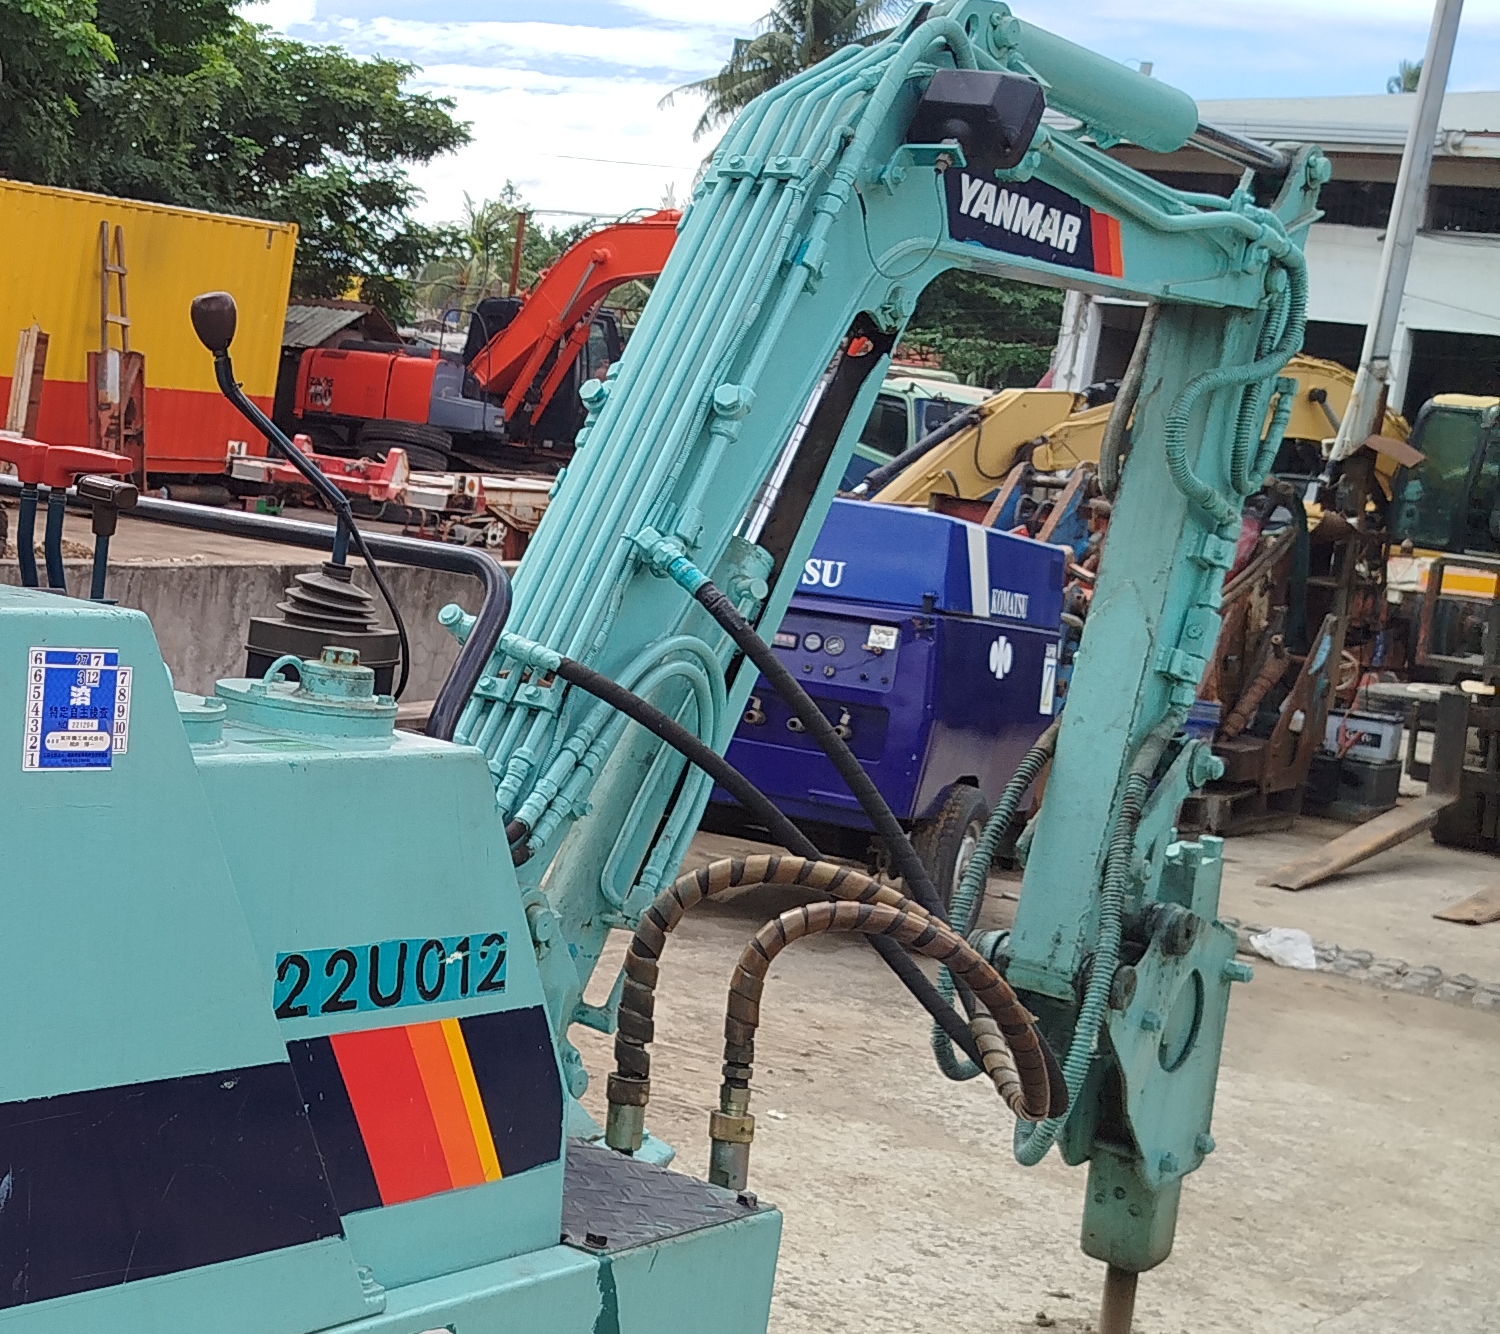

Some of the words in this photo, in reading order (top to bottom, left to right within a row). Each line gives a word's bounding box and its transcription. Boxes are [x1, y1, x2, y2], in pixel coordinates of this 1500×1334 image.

[959, 173, 1082, 254] YANMAR
[990, 589, 1028, 619] KOMATSU
[34, 669, 42, 682] 6
[87, 671, 99, 684] 12
[119, 671, 127, 684] 7
[32, 686, 41, 699] 5
[117, 688, 127, 702] 8
[31, 702, 40, 716] 4
[117, 705, 125, 717] 9
[30, 719, 38, 732] 3
[114, 721, 125, 734] 10
[29, 735, 38, 749] 2
[113, 737, 124, 749] 11
[26, 752, 35, 766] 1
[274, 933, 506, 1020] 22U012
